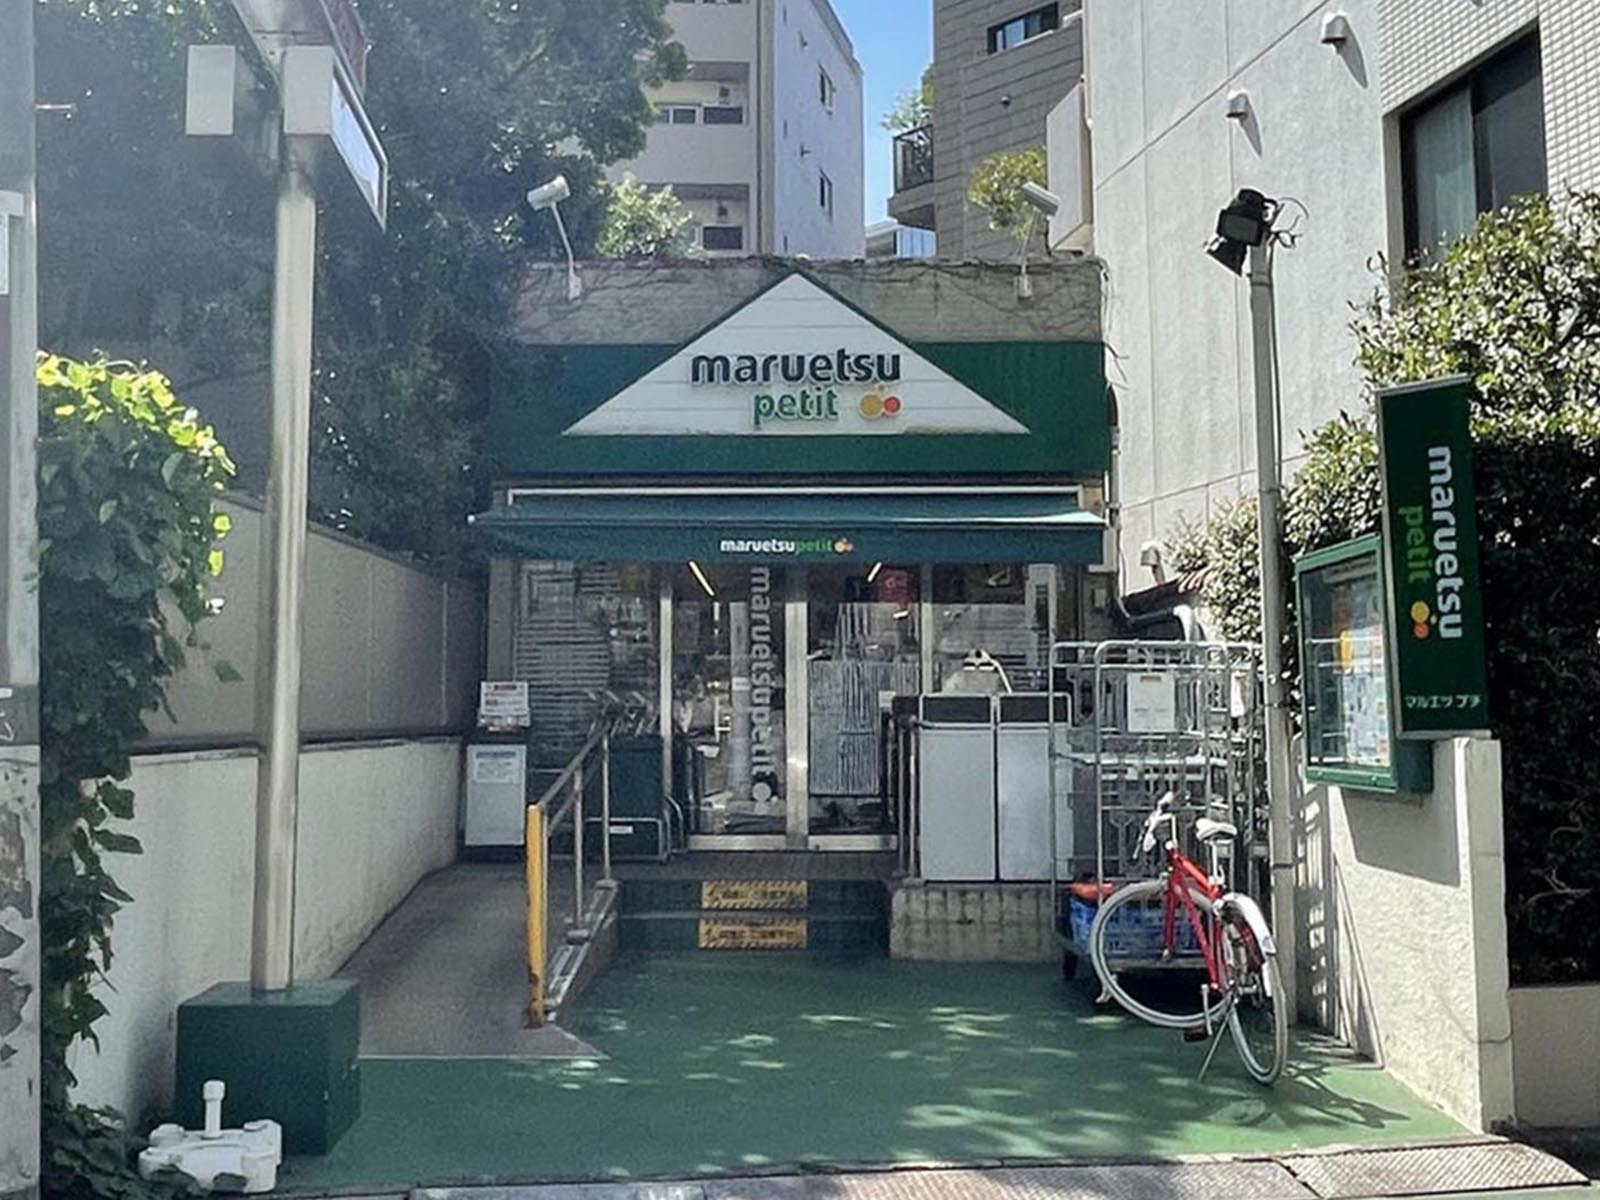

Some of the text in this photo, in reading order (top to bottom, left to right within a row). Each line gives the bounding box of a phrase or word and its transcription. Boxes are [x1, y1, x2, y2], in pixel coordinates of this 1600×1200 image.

[691, 348, 901, 383] maruetsu
[754, 387, 838, 426] petit
[1398, 506, 1433, 584] petit
[1428, 446, 1464, 638] maruetsu
